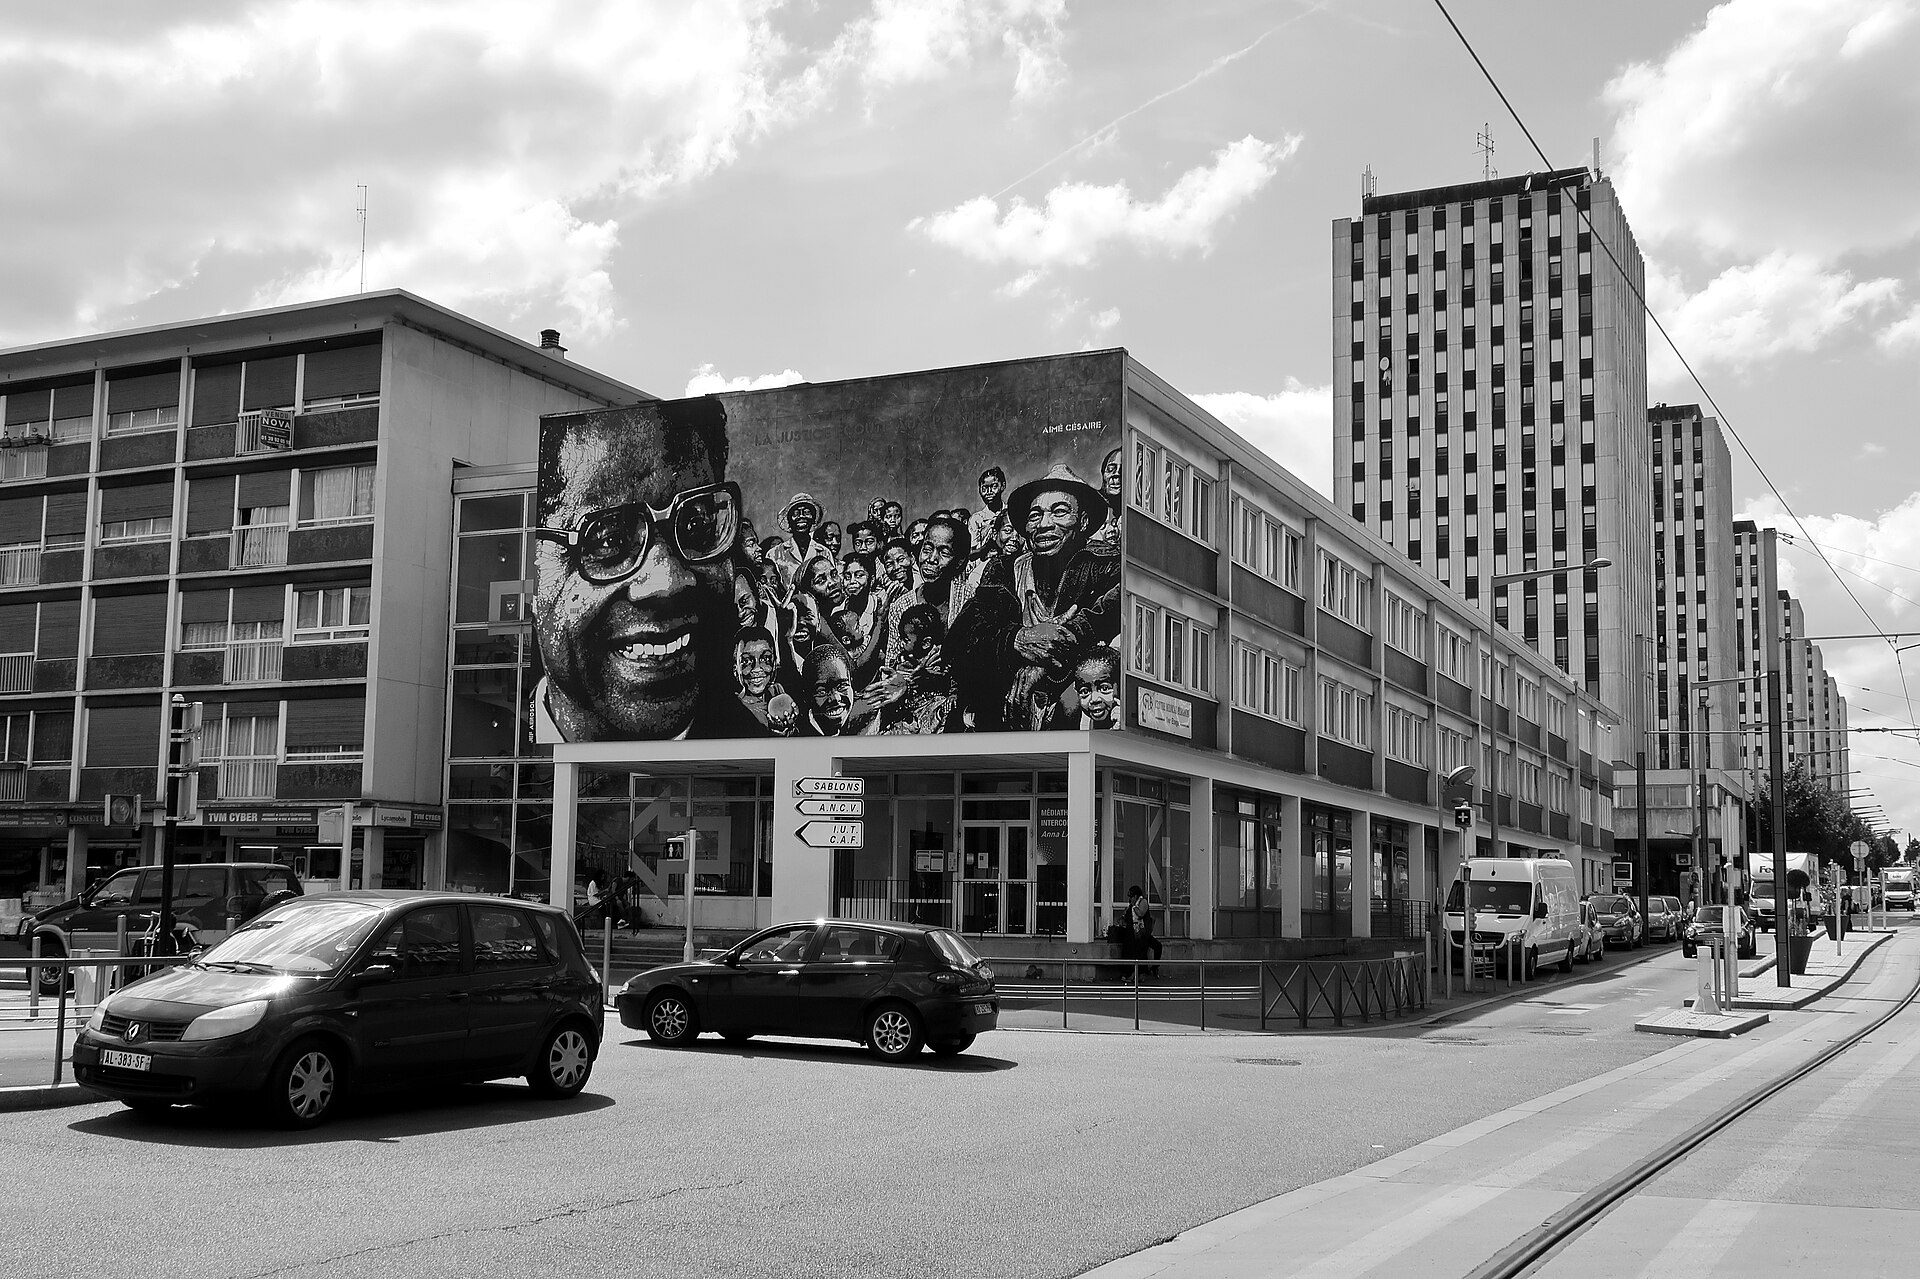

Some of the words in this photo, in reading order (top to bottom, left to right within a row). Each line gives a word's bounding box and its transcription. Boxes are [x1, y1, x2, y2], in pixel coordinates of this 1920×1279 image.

[265, 411, 289, 419] VENDU
[262, 417, 291, 429] NOVA
[1042, 423, 1063, 434] AIMÉ
[1065, 421, 1102, 431] CÉSAIRE
[813, 782, 860, 791] SABLONS
[819, 803, 859, 812] A.N.C.V.
[1040, 808, 1068, 816] MÉDIATH
[69, 814, 105, 823] COSMETI
[208, 812, 227, 822] TVM
[229, 812, 258, 822] CYBER
[1040, 819, 1068, 827] INTERCO
[833, 825, 859, 834] I.U.T.
[1041, 830, 1060, 838] Anna
[829, 835, 859, 844] C.A.F.
[105, 1051, 145, 1068] AL-383-SF
